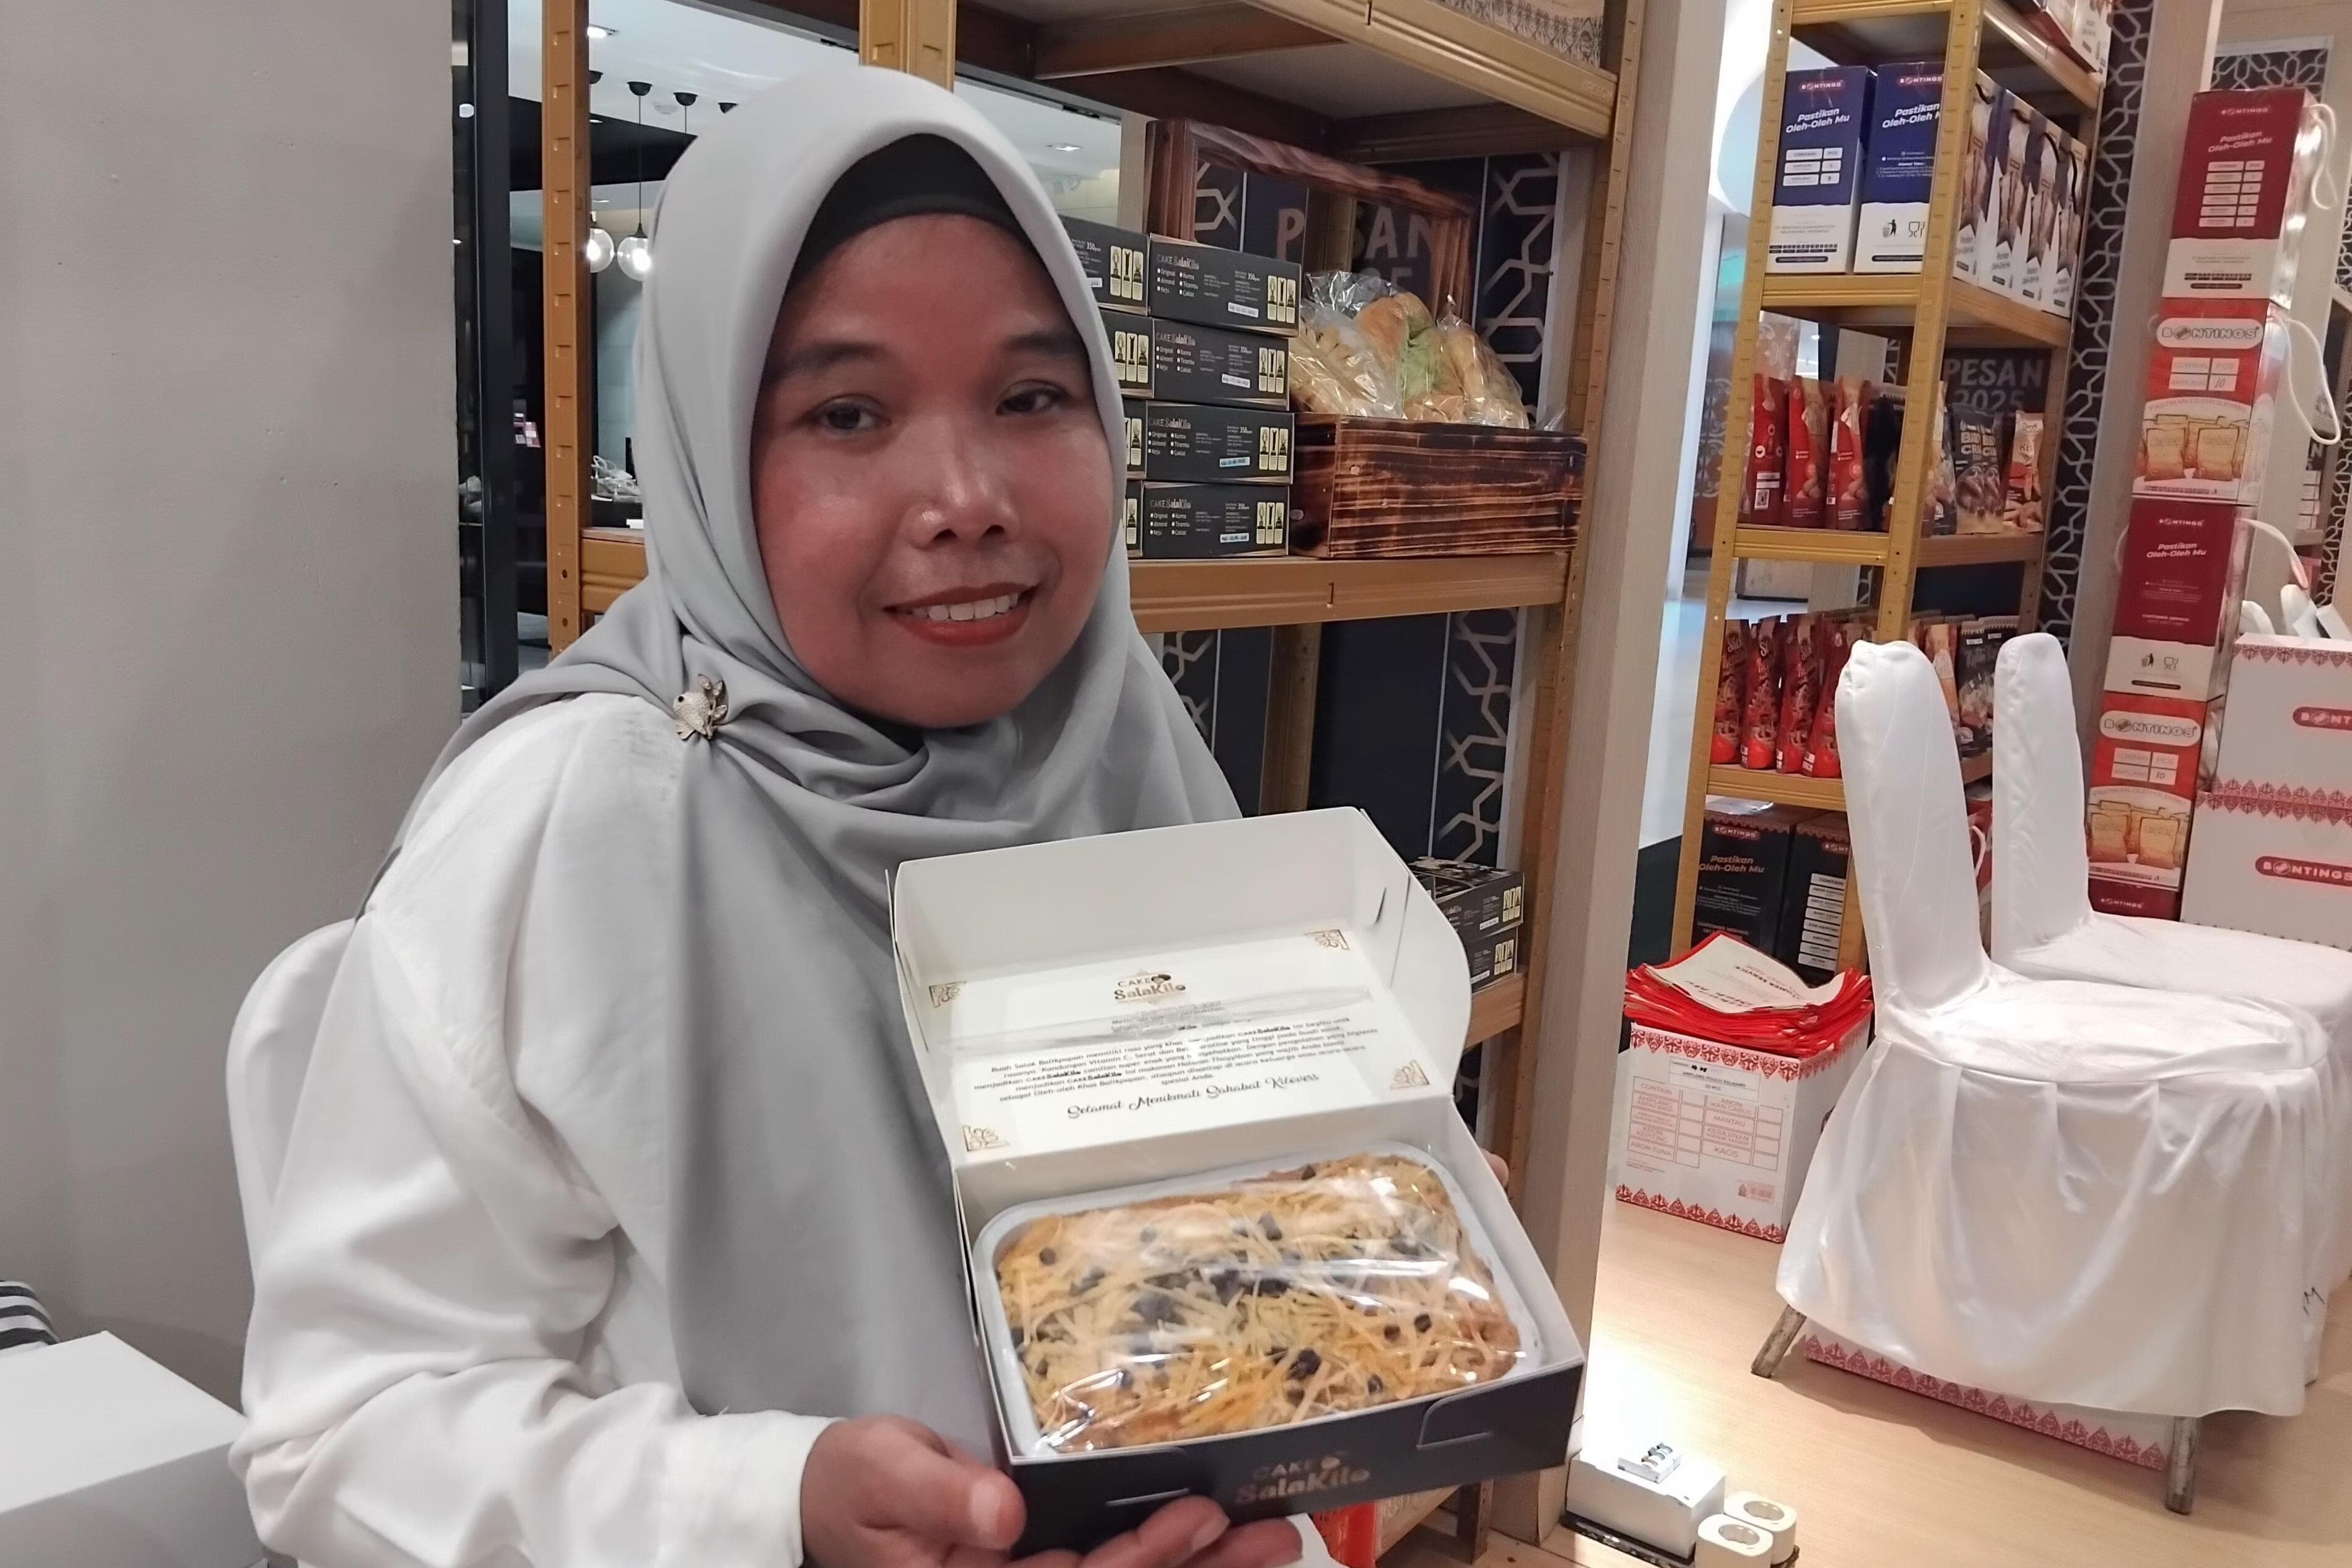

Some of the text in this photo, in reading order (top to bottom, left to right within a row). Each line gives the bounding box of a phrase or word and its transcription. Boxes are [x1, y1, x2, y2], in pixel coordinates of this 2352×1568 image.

[1797, 108, 1840, 123] Pastikan
[1894, 103, 1940, 118] Pastikan
[1785, 114, 1850, 133] Oleh-Oleh Mu
[1882, 112, 1933, 128] Oleh-Oleh
[2208, 136, 2273, 152] Oleh-Oleh Mu
[2219, 131, 2263, 144] Pastikan
[2162, 325, 2257, 341] BONTINGS
[1943, 358, 2044, 387] PESAN
[2146, 549, 2191, 558] Oleh-Oleh
[2158, 542, 2198, 551] Pastikan
[2104, 718, 2195, 738] BONTINGS
[1710, 855, 1754, 865] Pastikan
[1698, 863, 1765, 874] Oleh-Oleh Mu
[2263, 861, 2352, 881] BONTINGS
[1819, 877, 1844, 886] CONTAIN
[1117, 977, 1151, 987] CAKE
[991, 1064, 1011, 1072] Buah
[1014, 1061, 1035, 1069] Salak
[1039, 1053, 1084, 1066] Balikpapan
[1086, 1048, 1122, 1058] memiliki
[1305, 1020, 1331, 1028] begitu
[1041, 1061, 1086, 1073] Kandungan
[1088, 1055, 1121, 1065] Vitamin
[1252, 1034, 1274, 1042] tinggi
[1276, 1030, 1297, 1039] pada
[973, 1078, 1022, 1091] menjadikan
[1083, 1063, 1116, 1073] camilan
[1118, 1061, 1140, 1069] super
[1165, 1054, 1184, 1063] yang
[1246, 1041, 1276, 1052] Dengan
[1278, 1035, 1325, 1047] pengolahan
[1326, 1032, 1345, 1040] yang
[1014, 1079, 1065, 1091] menjadikan
[1138, 1063, 1175, 1073] makanan
[1255, 1048, 1274, 1058] yang
[1276, 1045, 1299, 1054] wajib
[1300, 1042, 1322, 1050] Anda
[999, 1091, 1031, 1102] sebagai
[1077, 1081, 1098, 1089] Khas
[1151, 1069, 1185, 1079] ataupun
[1187, 1063, 1222, 1075] disantap
[1260, 1053, 1296, 1065] keluarga
[1161, 1076, 1189, 1085] spesial
[1640, 1082, 1673, 1095] CONTAIN
[1066, 1100, 1122, 1119] Selamat
[1128, 1088, 1200, 1110] Menikmati
[1205, 1079, 1261, 1099] Sahabat
[1714, 1115, 1746, 1127] MANTAU
[1707, 1127, 1749, 1142] KERAJINAN
[1652, 1146, 1672, 1157] TUNA
[1714, 1146, 1738, 1158] KAOS
